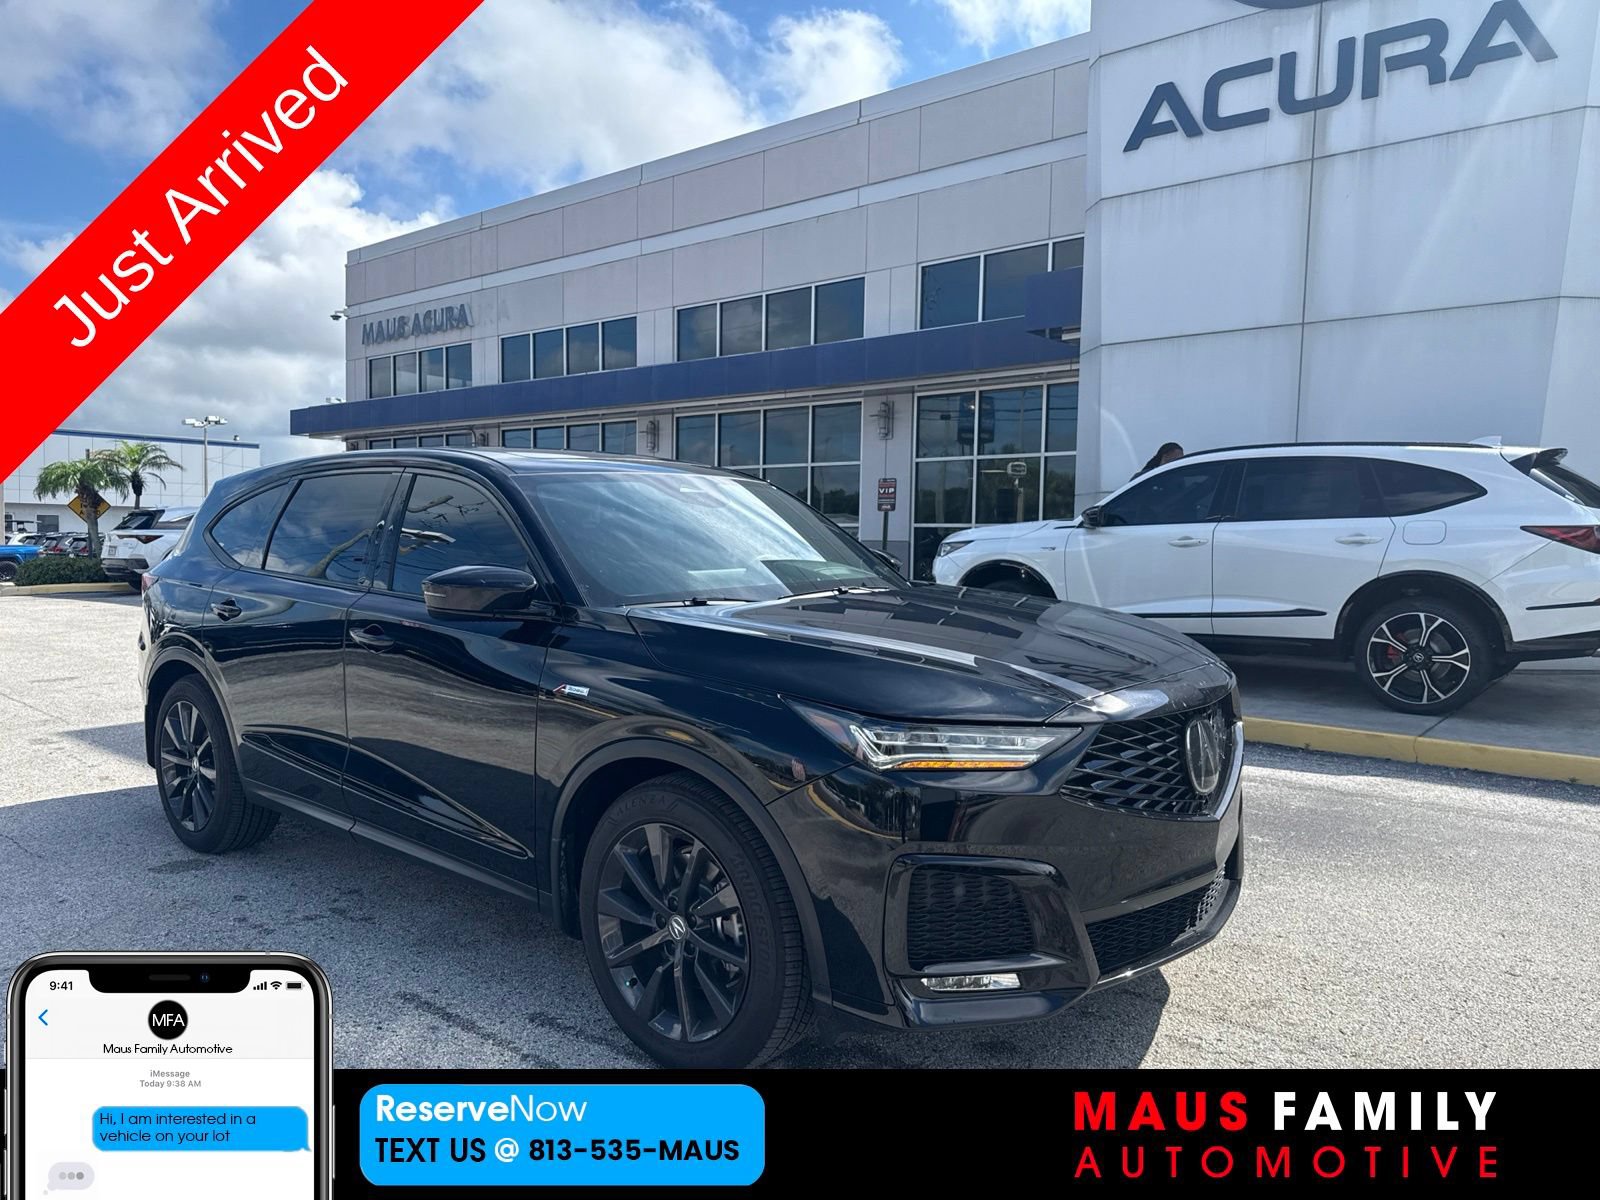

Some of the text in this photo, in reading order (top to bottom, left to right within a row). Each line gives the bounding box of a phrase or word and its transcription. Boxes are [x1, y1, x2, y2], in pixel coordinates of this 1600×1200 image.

[1123, 0, 1557, 152] ACURA
[362, 303, 469, 346] MAUS ACURA
